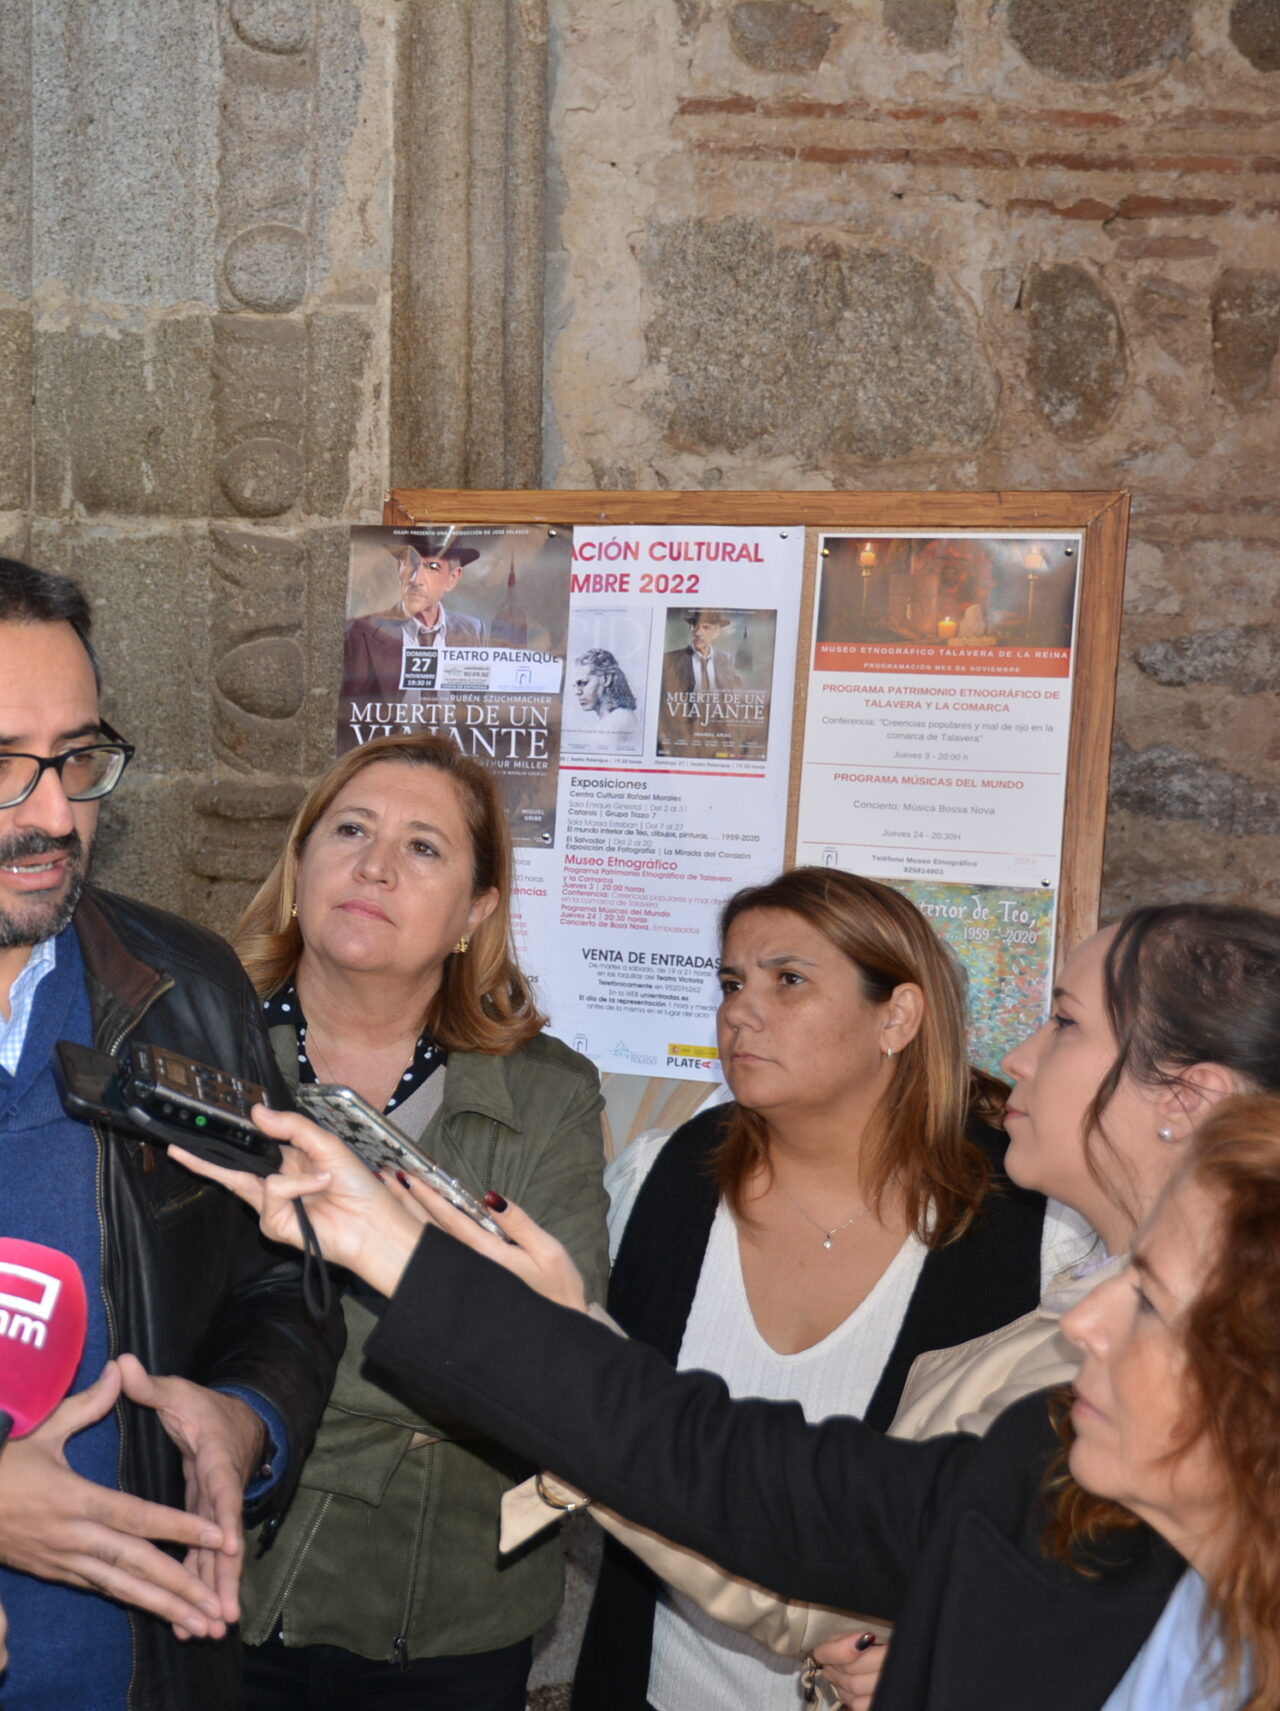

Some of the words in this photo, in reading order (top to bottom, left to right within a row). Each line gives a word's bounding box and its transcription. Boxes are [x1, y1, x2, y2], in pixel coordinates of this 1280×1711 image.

[648, 541, 765, 563] CULTURAL
[571, 573, 631, 593] MBRE
[639, 573, 701, 594] 2022
[442, 650, 489, 662] TEATRO
[493, 651, 560, 664] PALENQUE
[820, 644, 857, 654] MUSEO
[860, 645, 935, 657] ETNOGRÁFICO
[938, 647, 995, 659] TALAVERA
[999, 650, 1014, 659] DE
[1016, 650, 1031, 659] LA
[1034, 650, 1069, 660] REINA
[411, 658, 432, 672] 27
[863, 661, 932, 672] PROGRAMACIÓN
[934, 663, 953, 672] MES
[955, 664, 967, 672] DE
[969, 664, 1021, 673] NOVIEMBRE
[666, 691, 720, 704] MUERTE
[724, 693, 742, 704] DE
[745, 694, 766, 705] UN
[822, 683, 885, 695] PROGRAMA
[887, 685, 957, 698] PATRIMONIO
[959, 686, 1042, 700] ETNOGRÁFICO
[1044, 689, 1060, 700] DE
[450, 694, 480, 703] RUBÉN
[483, 694, 551, 704] SZUCHMACHER
[864, 698, 923, 710] TALAVERA
[925, 700, 934, 710] Y
[935, 701, 950, 711] LA
[952, 702, 1010, 713] COMARCA
[350, 702, 457, 724] MUERTE
[465, 704, 500, 726] DE
[509, 705, 550, 727] UN
[666, 702, 765, 726] VIAJANTE
[821, 716, 876, 727] Conferencia:
[928, 720, 972, 731] populares
[974, 723, 980, 732] y
[981, 721, 999, 731] mal
[1000, 722, 1013, 732] de
[1014, 723, 1030, 734] ojo
[1031, 724, 1044, 733] en
[1045, 723, 1054, 733] la
[349, 724, 549, 760] VANTE
[886, 731, 925, 741] comarca
[926, 731, 939, 742] de
[893, 751, 922, 760] Jueves
[924, 752, 931, 760] 3
[937, 752, 962, 761] 20:00
[962, 752, 969, 762] h
[513, 761, 548, 769] MILLER
[571, 777, 647, 790] Exposiciones
[833, 772, 899, 784] PROGRAMA
[901, 772, 953, 787] MÚSICAS
[955, 776, 978, 788] DEL
[980, 778, 1024, 790] MUNDO
[569, 790, 595, 798] Centro
[596, 791, 625, 800] Cultural
[627, 793, 651, 801] Rafael
[652, 794, 682, 802] Morales
[605, 810, 629, 818] Grupo
[852, 800, 901, 812] Concierto:
[902, 800, 936, 813] Música
[938, 804, 968, 814] Bossa
[970, 805, 996, 816] Nova
[574, 836, 605, 844] Salvador
[679, 831, 709, 840] pinturas,
[721, 833, 760, 842] 1959-2020
[882, 828, 911, 838] Jueves
[912, 830, 924, 839] 24
[931, 831, 961, 841] 20:30H
[565, 843, 604, 852] Exposición
[617, 846, 656, 855] Fotografía
[674, 849, 701, 857] Mirada
[718, 851, 751, 859] Corazón
[564, 854, 604, 866] Museo
[607, 856, 678, 871] Etnográfico
[872, 854, 905, 864] Teléfono
[906, 856, 931, 865] Museo
[932, 857, 978, 868] Etnográfico
[564, 866, 599, 875] Programa
[601, 868, 640, 877] Patrimonio
[642, 870, 685, 880] Etnográfico
[699, 874, 732, 882] Talavera
[903, 866, 944, 876] 925814903
[560, 904, 597, 913] Programa
[598, 906, 628, 915] Músicas
[644, 909, 670, 918] Mundo
[920, 898, 968, 920] terior
[972, 894, 990, 922] de
[998, 900, 1038, 929] Teo,
[963, 926, 990, 941] 1959
[1006, 928, 1038, 944] 2020
[582, 947, 624, 963] VENTA
[628, 952, 646, 964] DE
[650, 953, 721, 970] ENTRADAS
[656, 974, 677, 982] Teatro
[678, 976, 704, 984] Victoria
[666, 1056, 712, 1069] PLATEA
